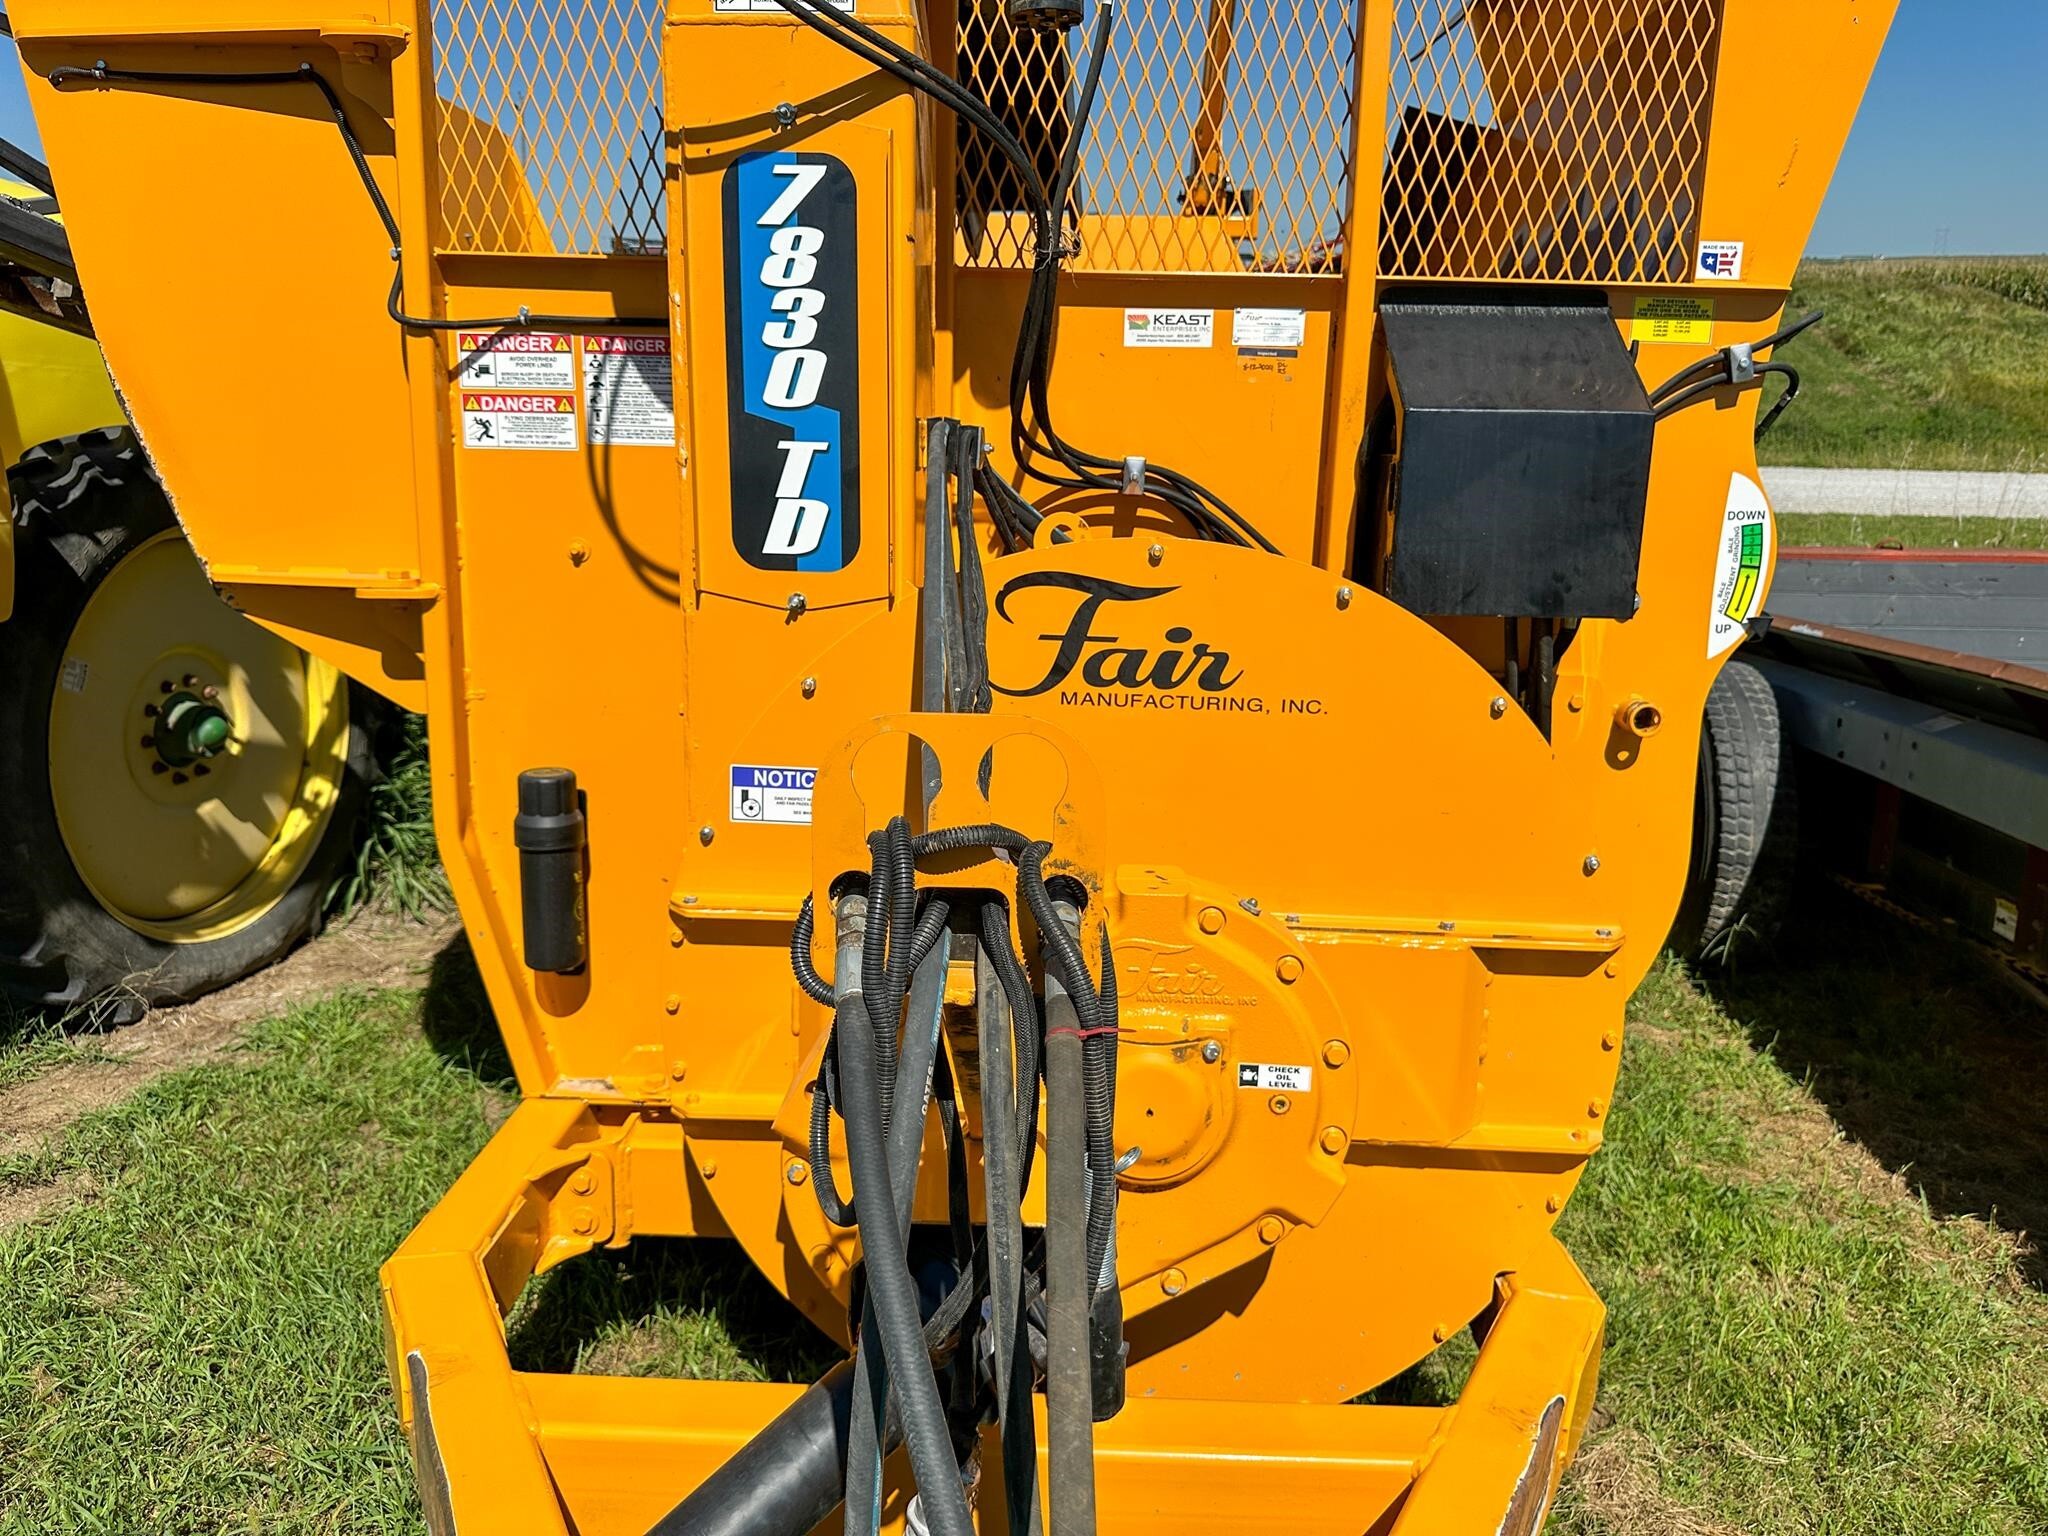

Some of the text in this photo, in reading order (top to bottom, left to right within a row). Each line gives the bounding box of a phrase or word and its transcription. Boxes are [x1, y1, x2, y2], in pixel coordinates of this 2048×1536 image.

[1153, 314, 1211, 326] KEAST
[477, 336, 553, 352] DANGER
[601, 338, 666, 352] DANGER
[756, 164, 830, 556] 7830 TD
[481, 397, 557, 412] DANGER
[1727, 510, 1766, 521] DOWN
[1732, 526, 1740, 563] GRINDING
[1717, 582, 1726, 598] BALE
[1718, 566, 1737, 614] ADJUSTMENT
[987, 571, 1244, 697] Fair
[1715, 624, 1732, 634] UP
[1060, 691, 1329, 715] MANUFACTURING, INC.
[753, 769, 815, 789] NOTIC
[1114, 937, 1225, 998] Fair
[1268, 1065, 1301, 1075] CHECK
[1268, 1081, 1298, 1089] LEVEL
